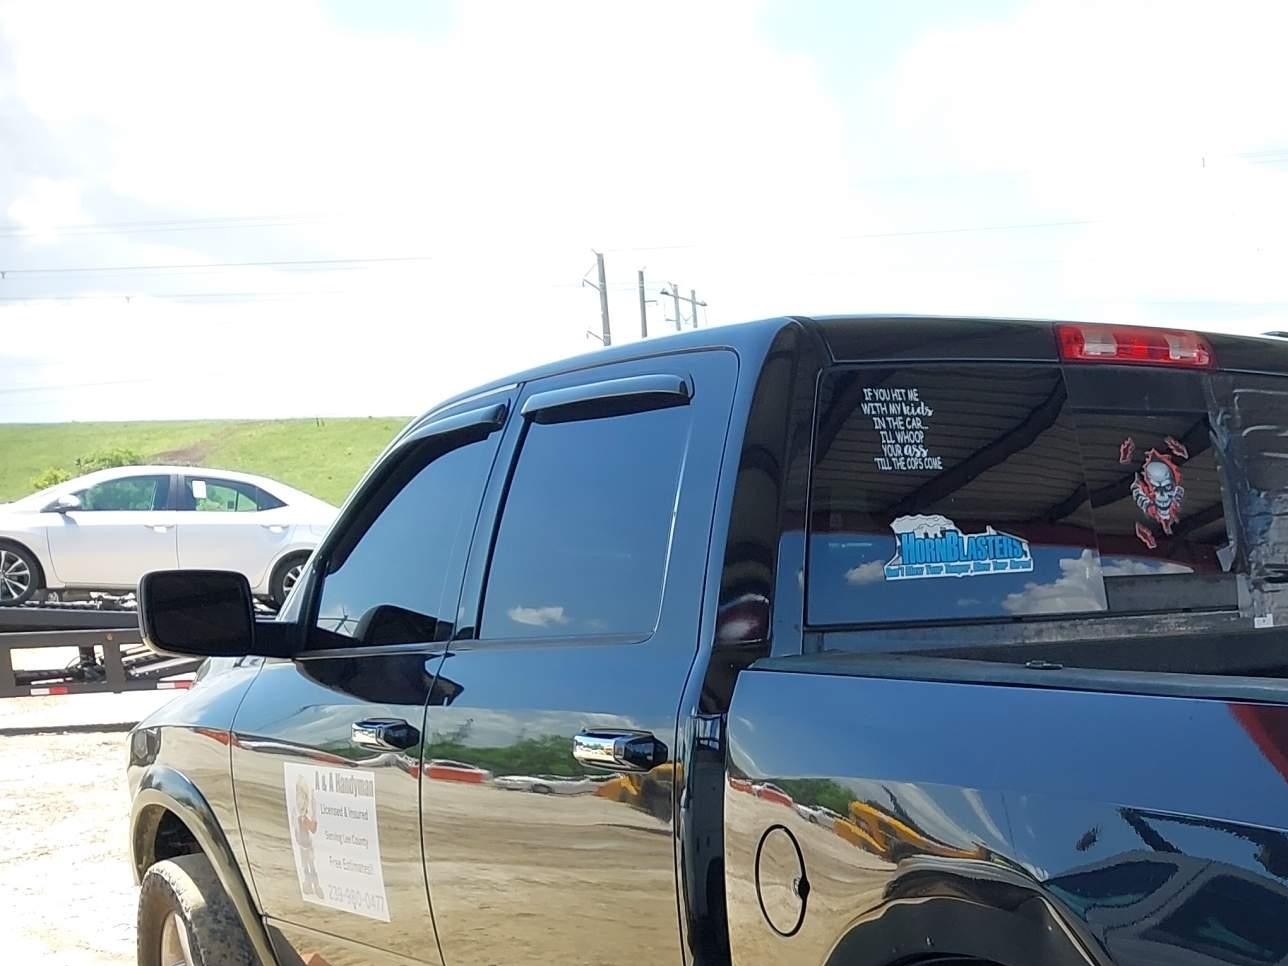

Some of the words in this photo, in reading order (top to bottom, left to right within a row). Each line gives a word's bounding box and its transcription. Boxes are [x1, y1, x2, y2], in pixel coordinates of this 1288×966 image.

[863, 388, 872, 401] IF
[873, 388, 890, 401] YOU
[891, 388, 906, 401] HIT
[907, 388, 919, 402] ME
[861, 403, 887, 415] WITH
[888, 402, 901, 415] MY
[902, 401, 934, 416] kids
[872, 417, 887, 430] IN
[886, 417, 905, 430] THE
[895, 431, 924, 444] WHOOP
[882, 444, 903, 457] YOUR
[903, 444, 928, 458] ass
[891, 457, 907, 470] THE
[906, 458, 924, 470] COPS
[923, 457, 943, 470] COME
[335, 773, 374, 797] Handyman
